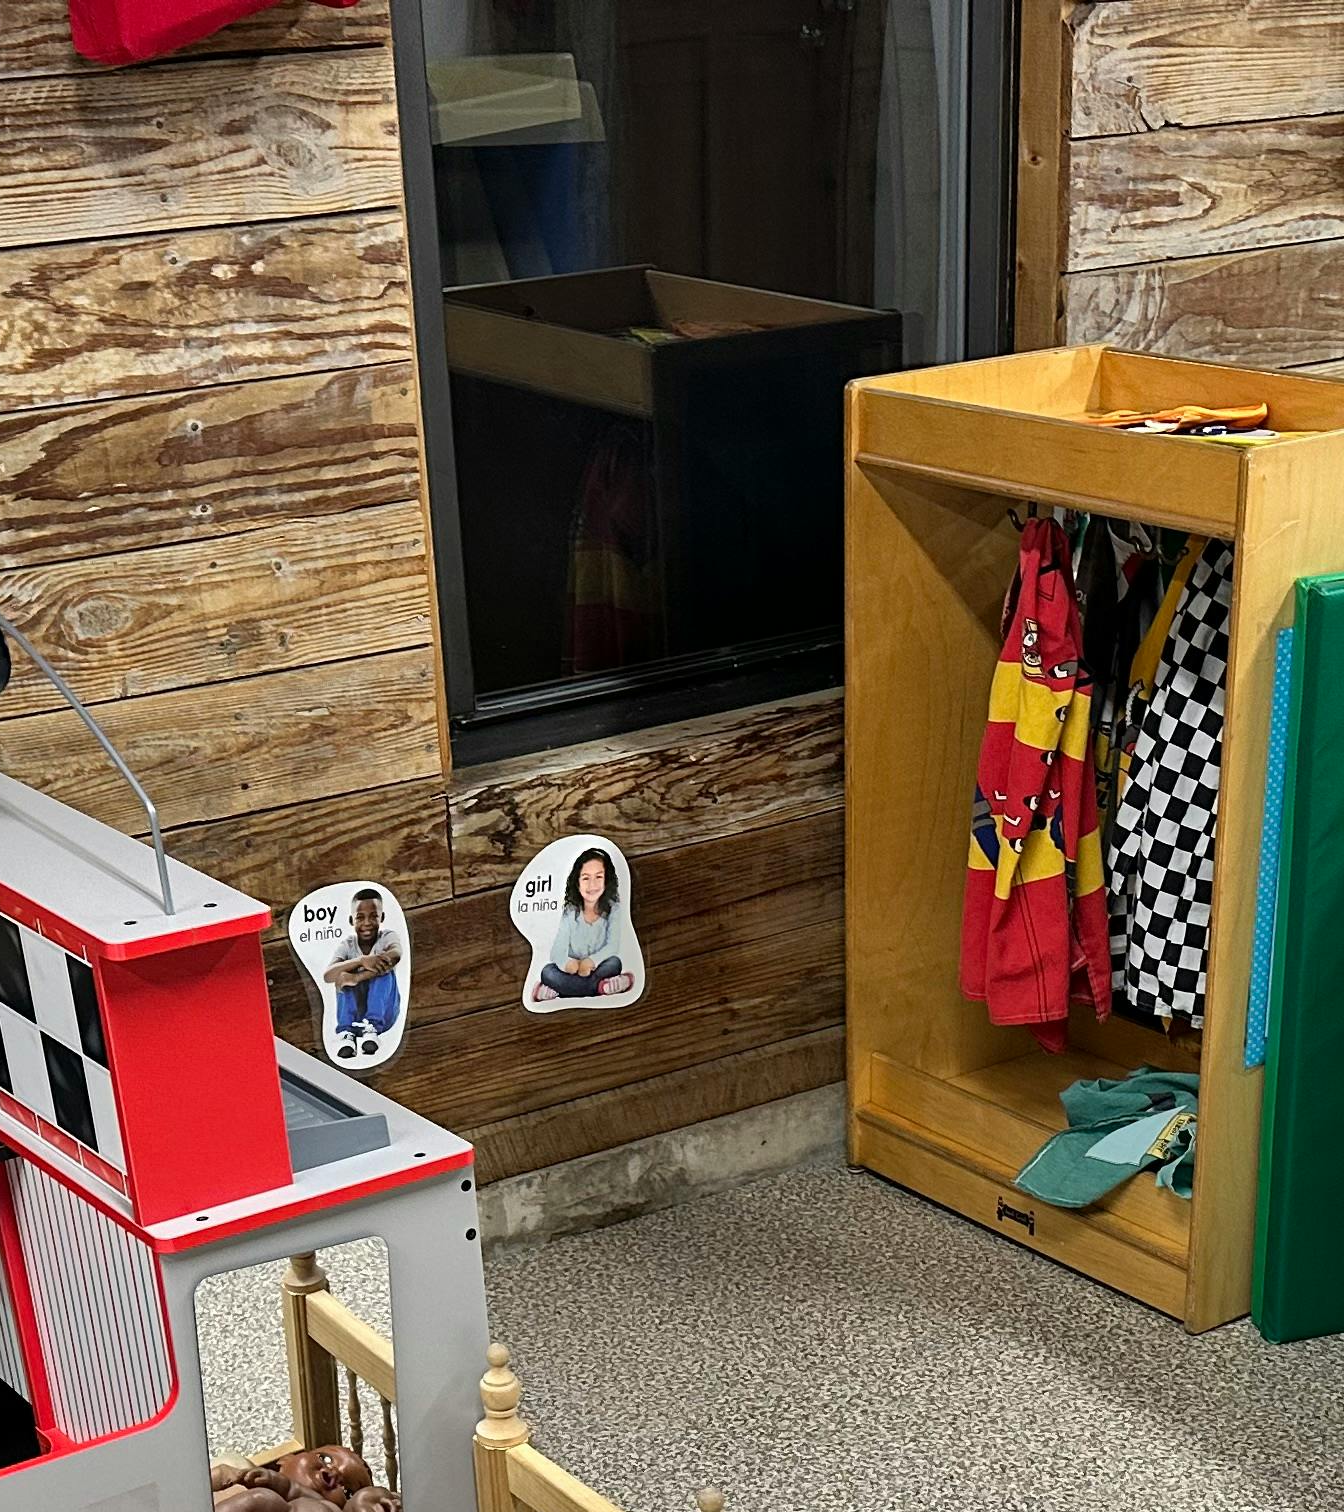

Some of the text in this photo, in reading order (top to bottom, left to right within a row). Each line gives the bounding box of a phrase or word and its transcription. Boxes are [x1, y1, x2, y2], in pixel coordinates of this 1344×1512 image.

[525, 874, 552, 899] girl
[303, 902, 337, 926] boy
[517, 896, 558, 914] la niña
[299, 924, 343, 943] el niño
